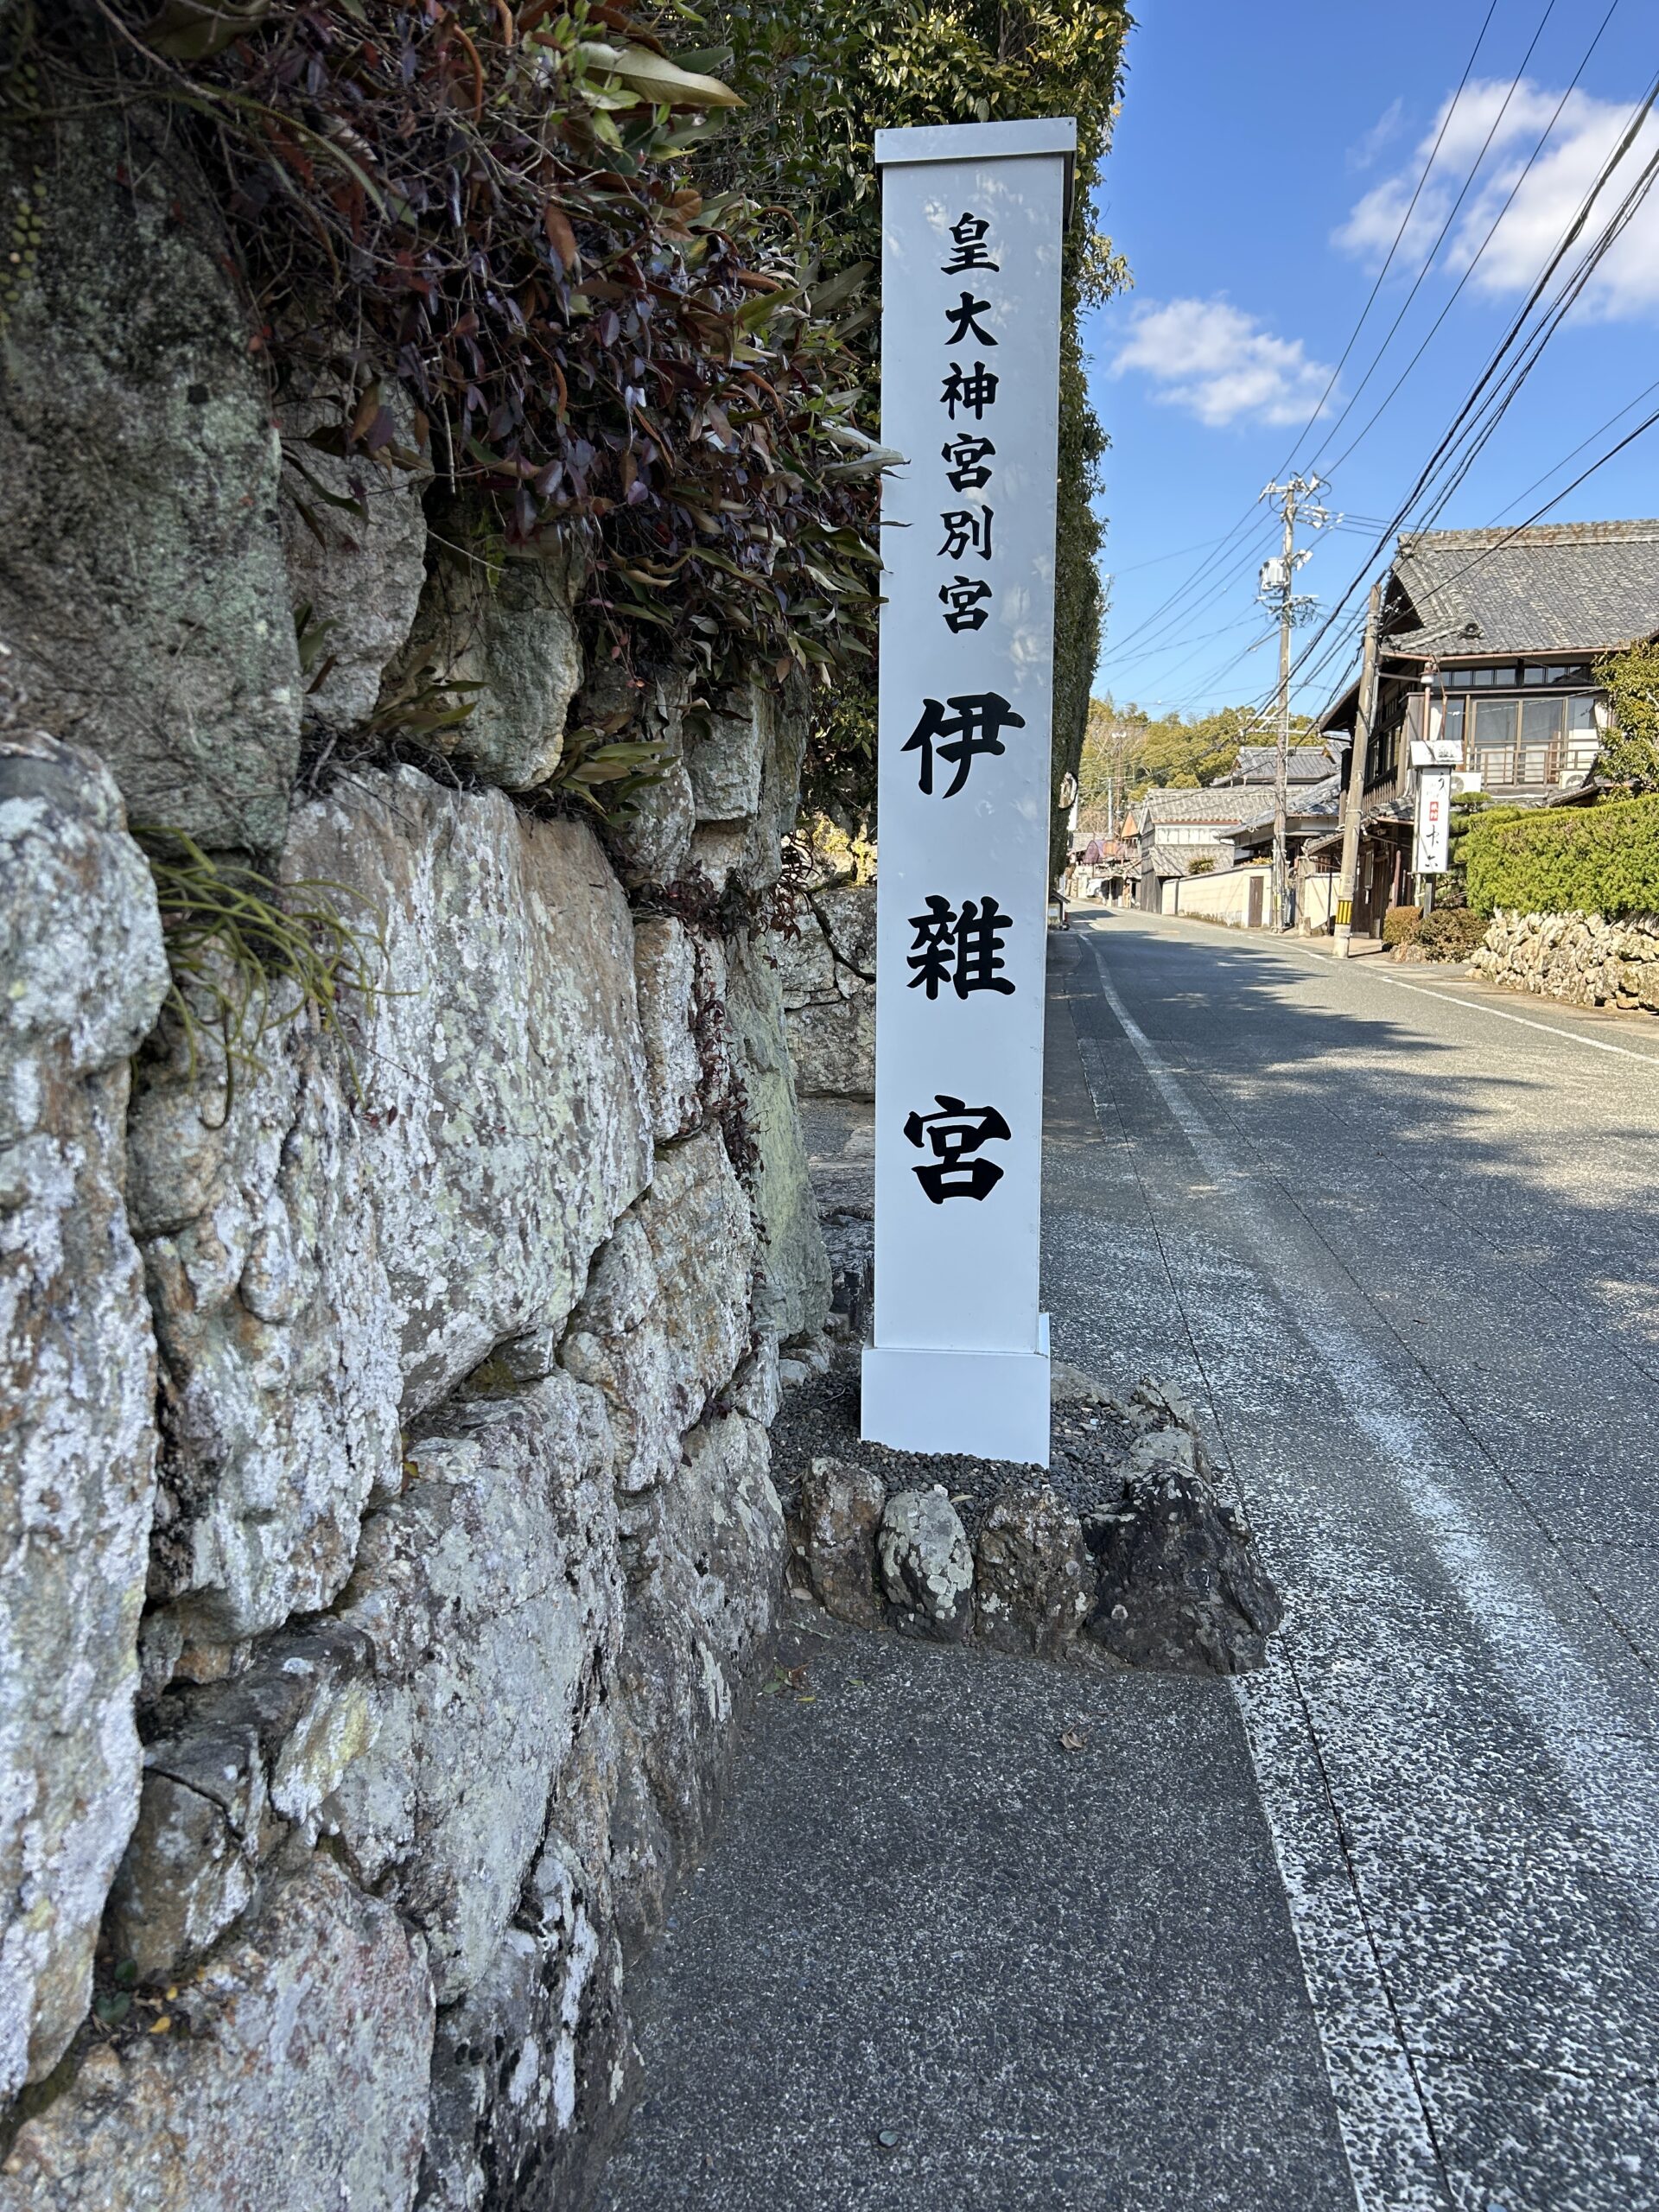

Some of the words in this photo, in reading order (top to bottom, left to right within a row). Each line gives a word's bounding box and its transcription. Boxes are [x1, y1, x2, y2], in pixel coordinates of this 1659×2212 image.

[938, 212, 1000, 634] 皇大神宮別宮
[900, 691, 1026, 1205] 伊雜宮
